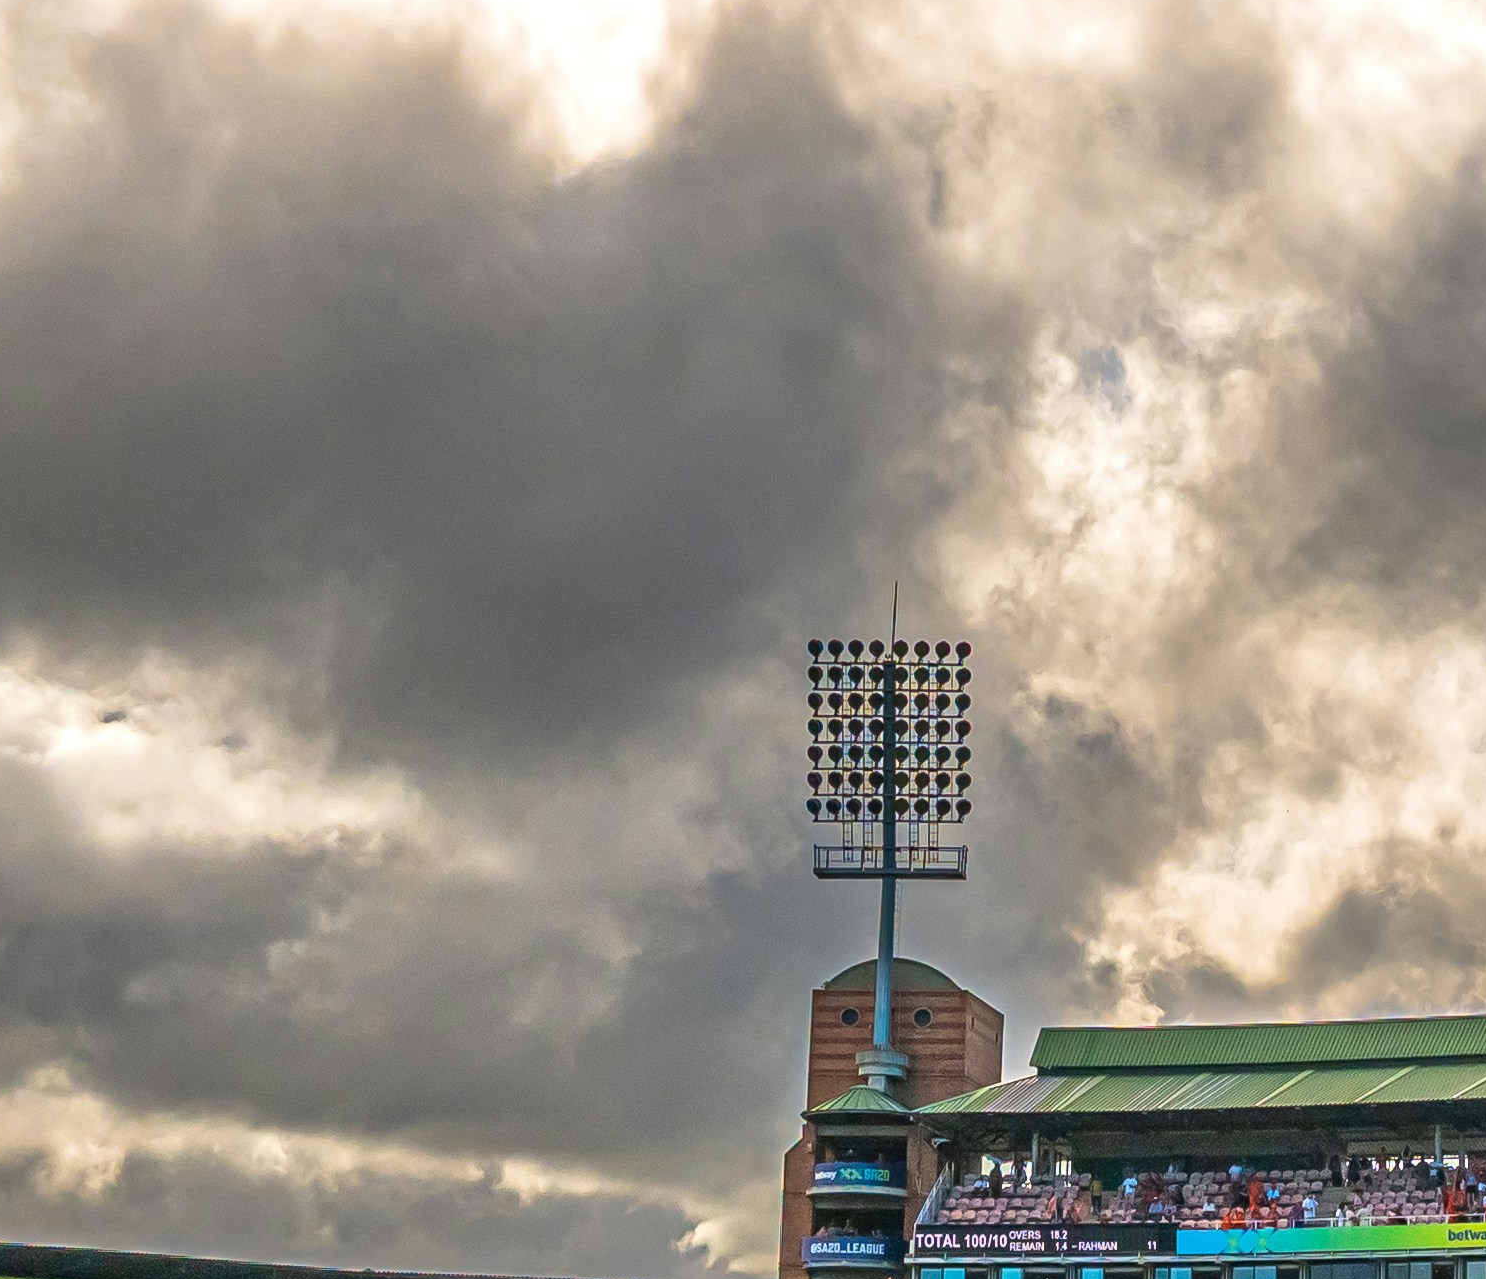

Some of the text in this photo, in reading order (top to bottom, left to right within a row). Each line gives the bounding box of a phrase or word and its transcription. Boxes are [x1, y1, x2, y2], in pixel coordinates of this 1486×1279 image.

[1009, 1230, 1041, 1240] OVERS
[915, 1233, 1007, 1248] TOTAL 100/10
[1009, 1241, 1044, 1251] REMAIN
[1147, 1241, 1157, 1250] 11
